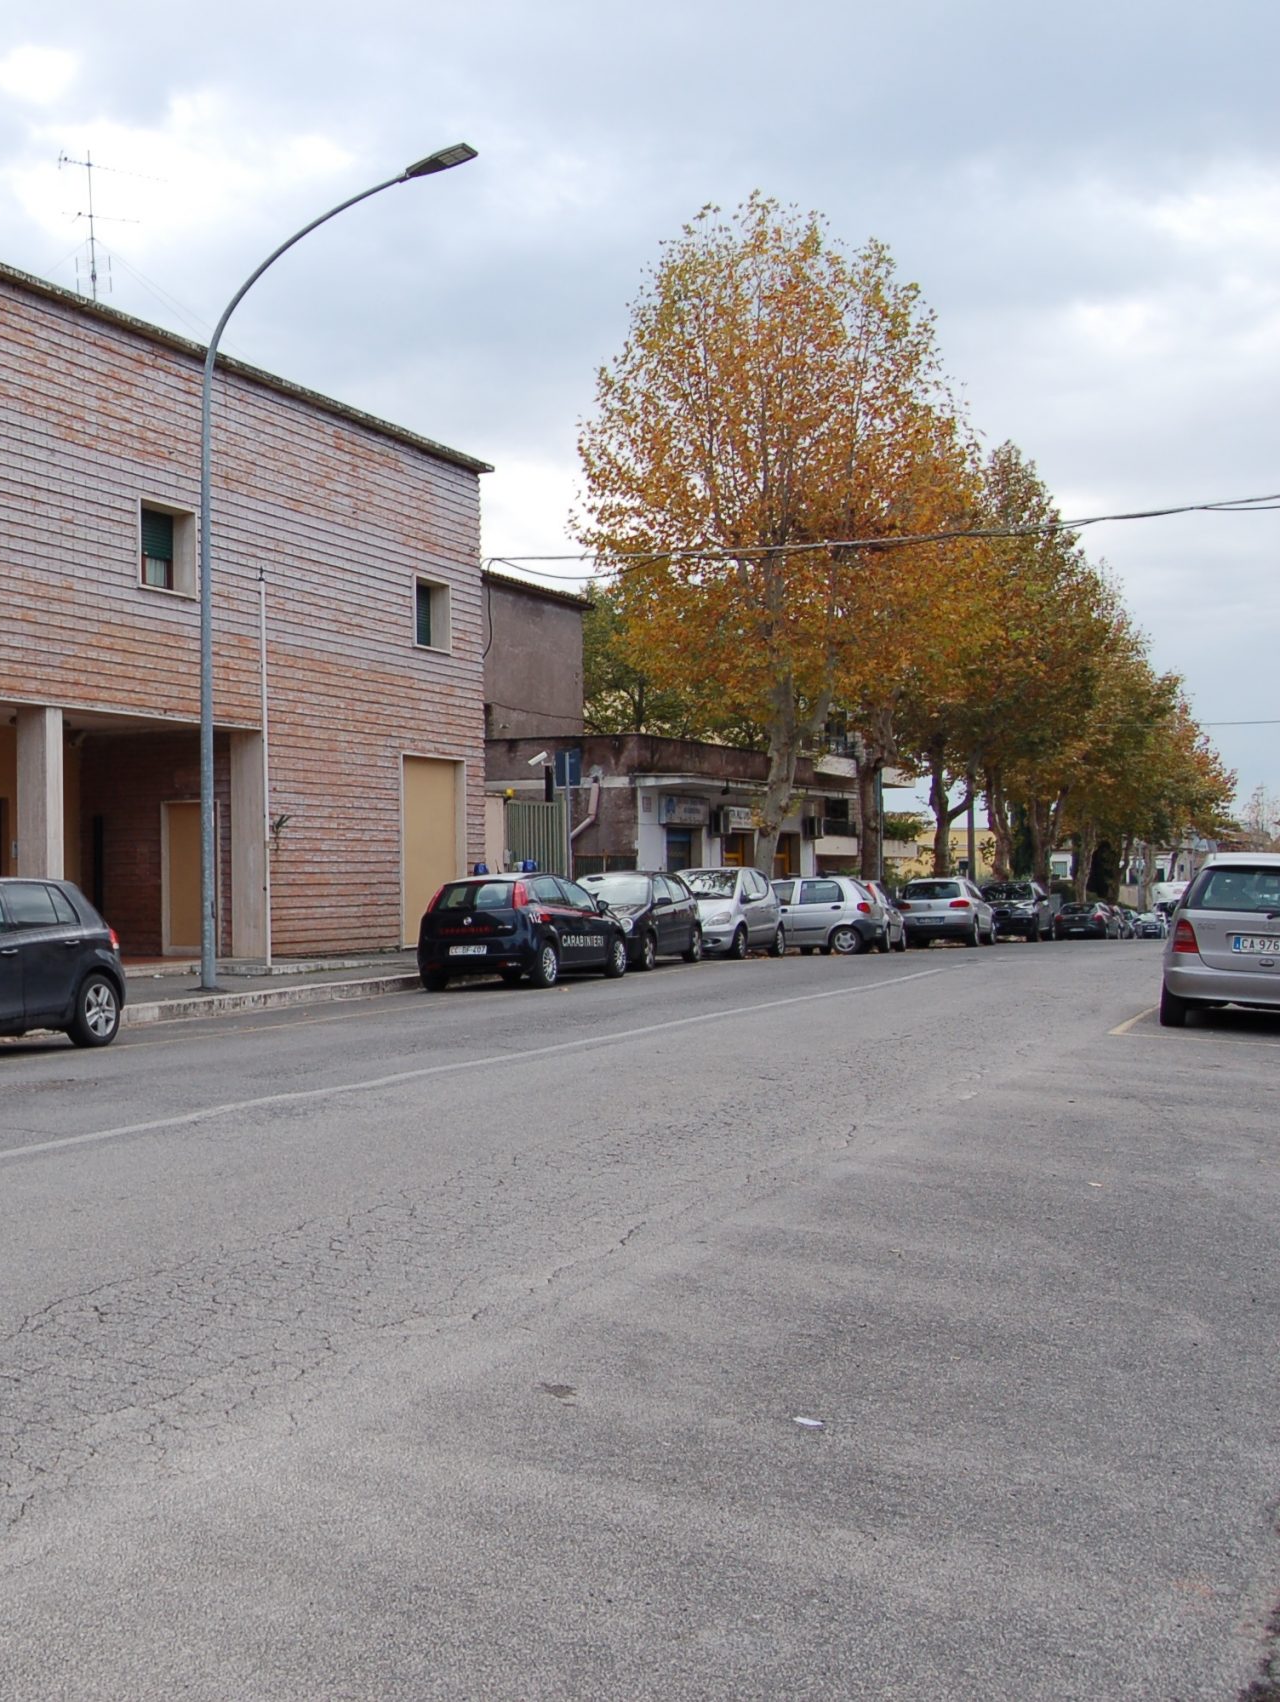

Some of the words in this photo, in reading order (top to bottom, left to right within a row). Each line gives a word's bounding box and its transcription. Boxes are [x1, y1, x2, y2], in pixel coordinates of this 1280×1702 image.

[528, 912, 542, 924] 112
[561, 935, 604, 947] CARABINIERI
[1259, 939, 1280, 951] 976
